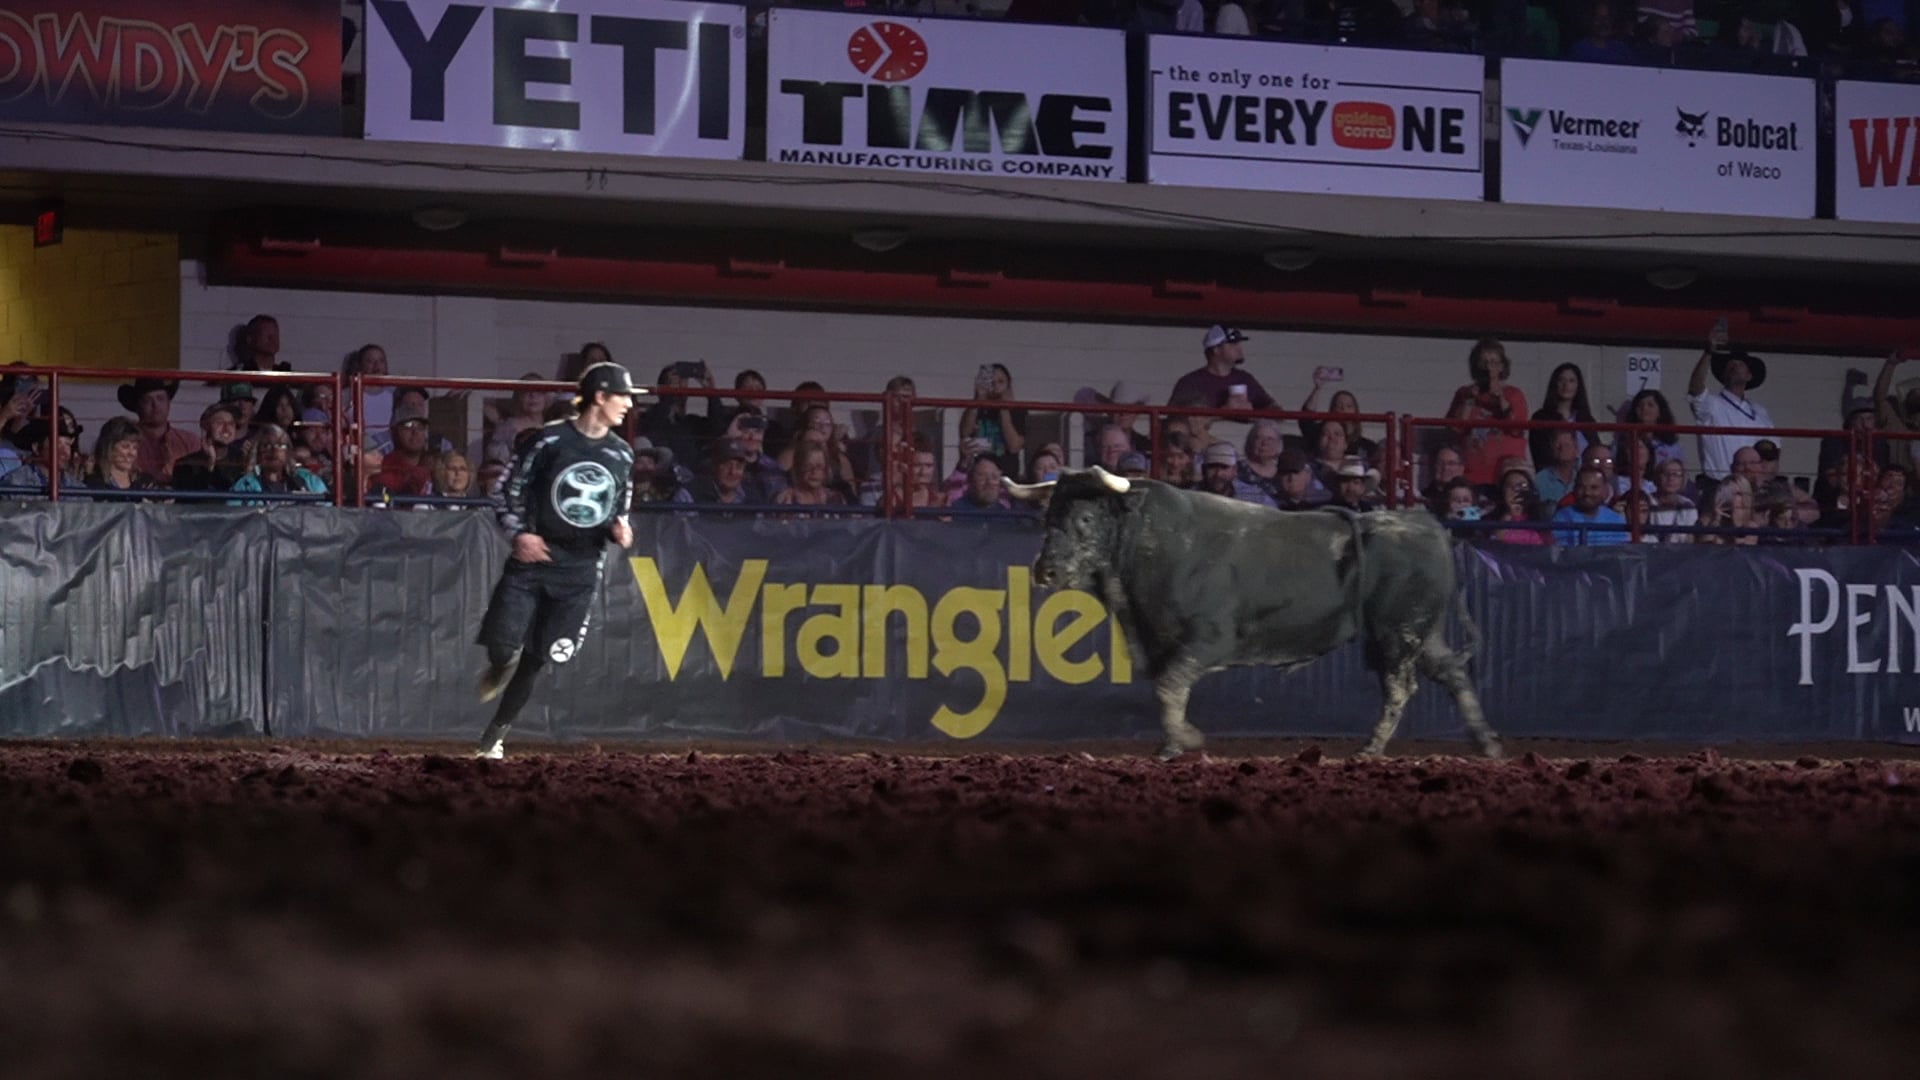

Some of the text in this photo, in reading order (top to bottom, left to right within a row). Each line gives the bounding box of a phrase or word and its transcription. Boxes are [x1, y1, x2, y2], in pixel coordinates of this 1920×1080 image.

[368, 0, 731, 141] YETI
[1169, 66, 1331, 90] the only one for
[780, 79, 1112, 160] TIME
[1334, 111, 1387, 128] golden
[1549, 109, 1640, 139] Vermeer
[1343, 124, 1393, 140] corral
[1717, 116, 1798, 151] Bobcat
[1553, 138, 1638, 155] Texas-Louisiana
[780, 148, 1114, 178] MANUFACTURING COMPANY
[1717, 161, 1782, 180] of Waco
[1628, 357, 1660, 373] BOX
